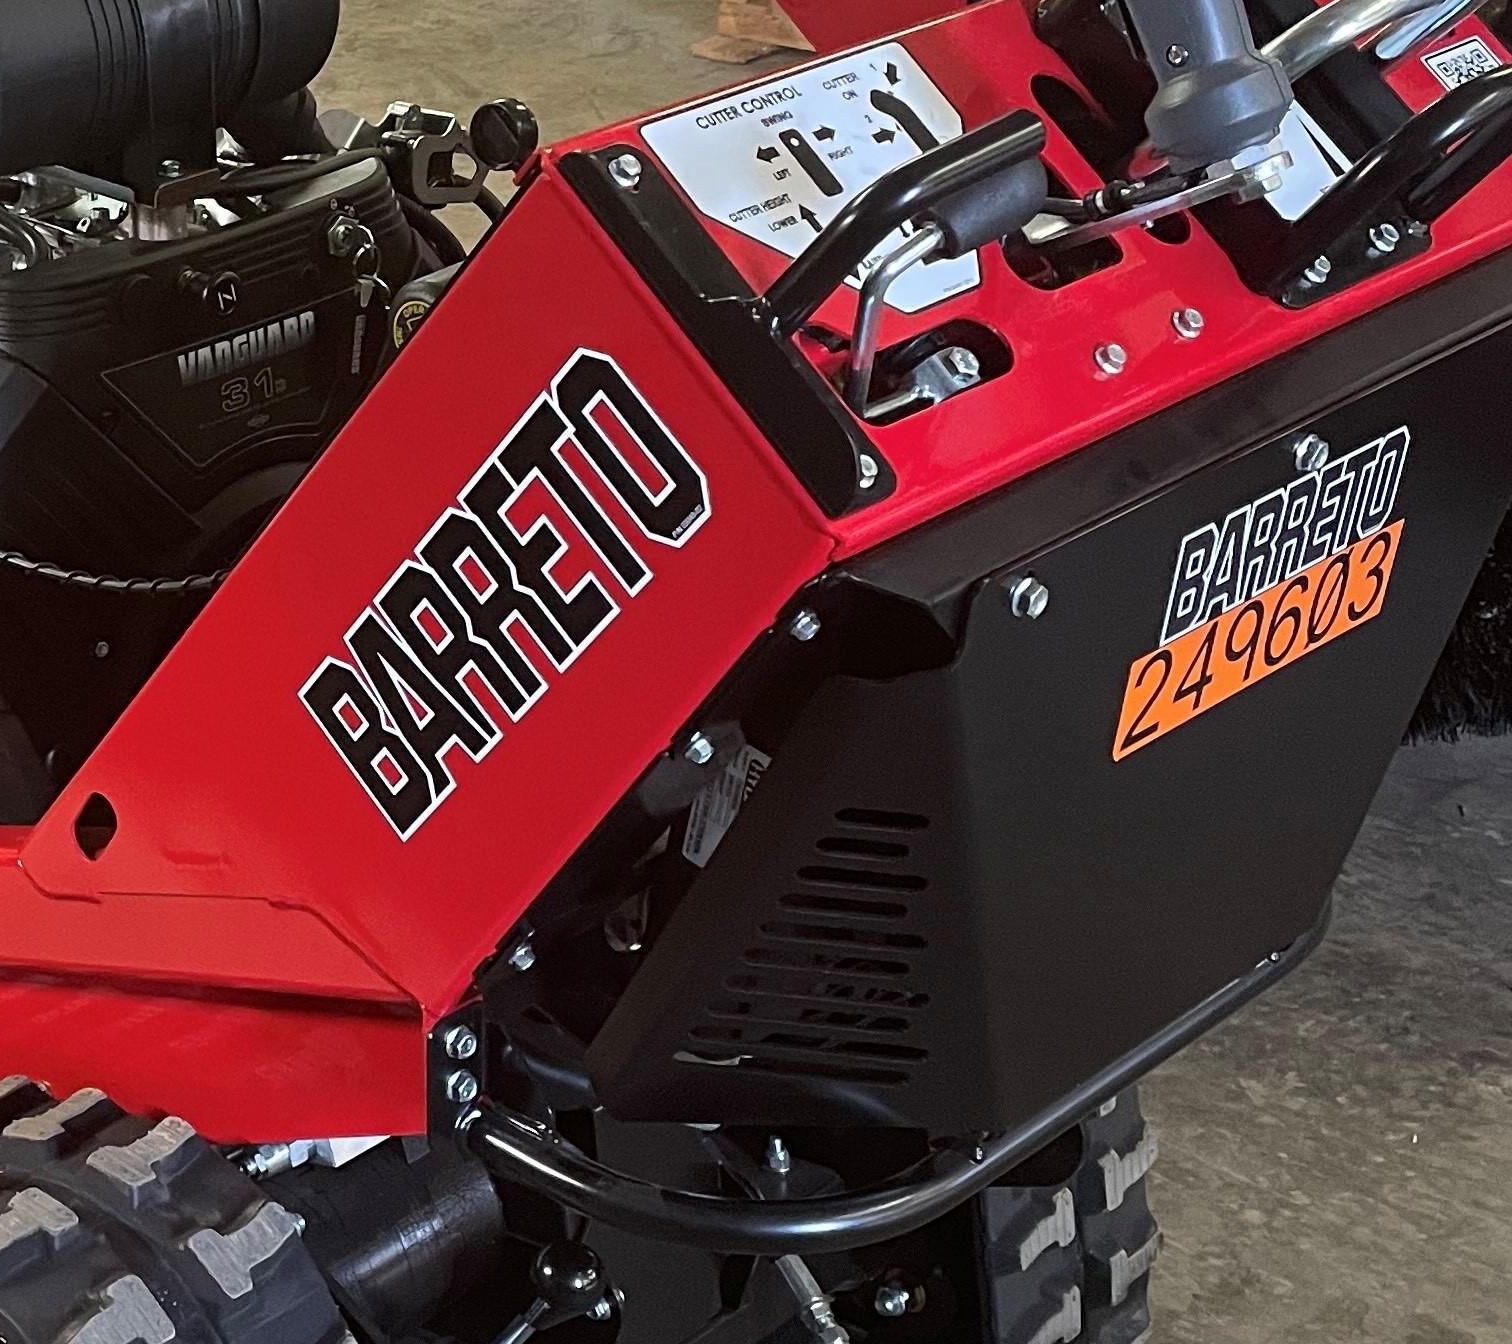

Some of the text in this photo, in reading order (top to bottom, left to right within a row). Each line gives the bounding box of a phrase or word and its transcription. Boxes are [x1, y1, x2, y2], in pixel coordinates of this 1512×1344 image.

[822, 72, 861, 91] CUTTER
[842, 90, 859, 101] ON
[695, 85, 803, 130] CUTTER CONTROL
[760, 111, 794, 128] SWING
[828, 145, 854, 161] RIGHT
[772, 168, 792, 181] LEFT
[728, 194, 792, 223] CUTTER HEIGHT
[768, 215, 799, 233] LOWER
[177, 309, 316, 387] VANGUARD
[220, 366, 275, 413] 31
[1159, 425, 1411, 648] BARRETO
[297, 347, 712, 843] BARRETO
[1119, 529, 1392, 753] 249603
